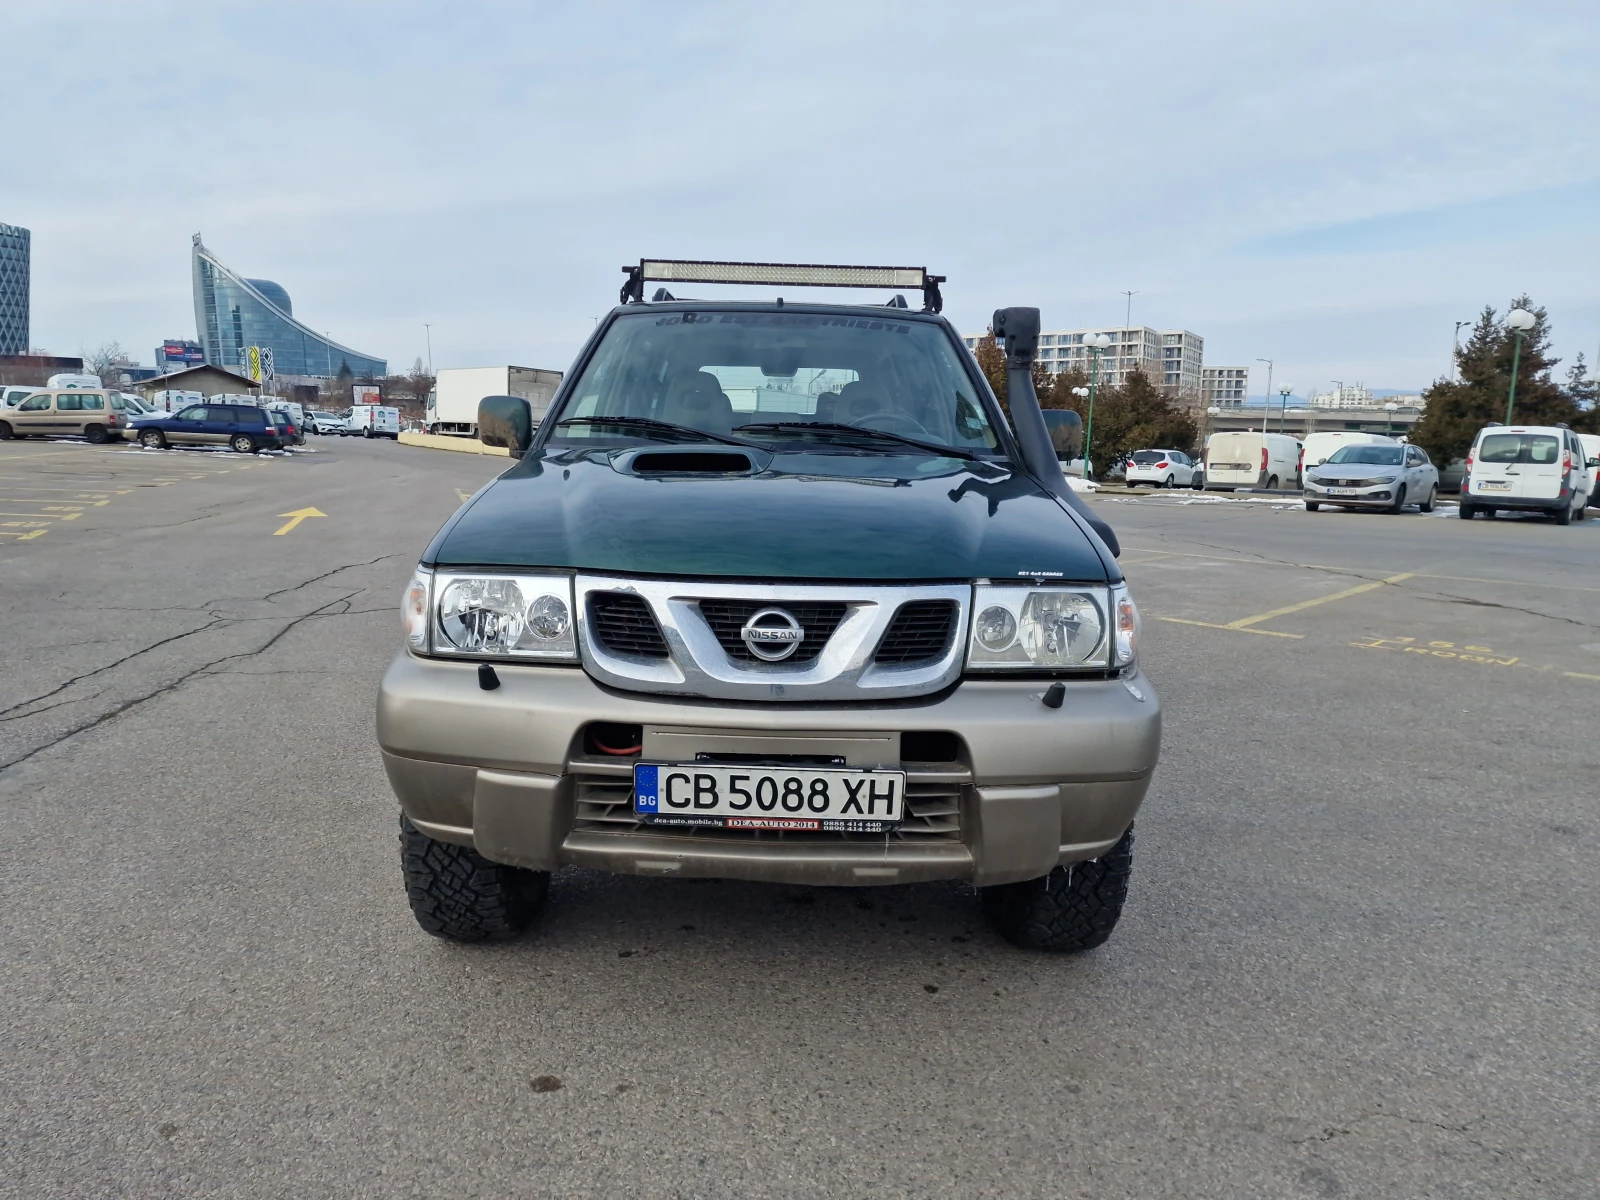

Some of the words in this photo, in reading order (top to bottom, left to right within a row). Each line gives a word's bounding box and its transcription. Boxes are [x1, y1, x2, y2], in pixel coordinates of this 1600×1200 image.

[821, 317, 912, 334] TRIESTE
[748, 630, 797, 640] NISSAN
[665, 772, 720, 809] CB
[728, 775, 830, 813] 5088
[840, 778, 895, 815] XH
[639, 795, 656, 806] BG
[653, 817, 723, 827] dea-auto.mobile.bg
[731, 820, 790, 828] DEA-AUTO
[793, 821, 816, 829] 2014
